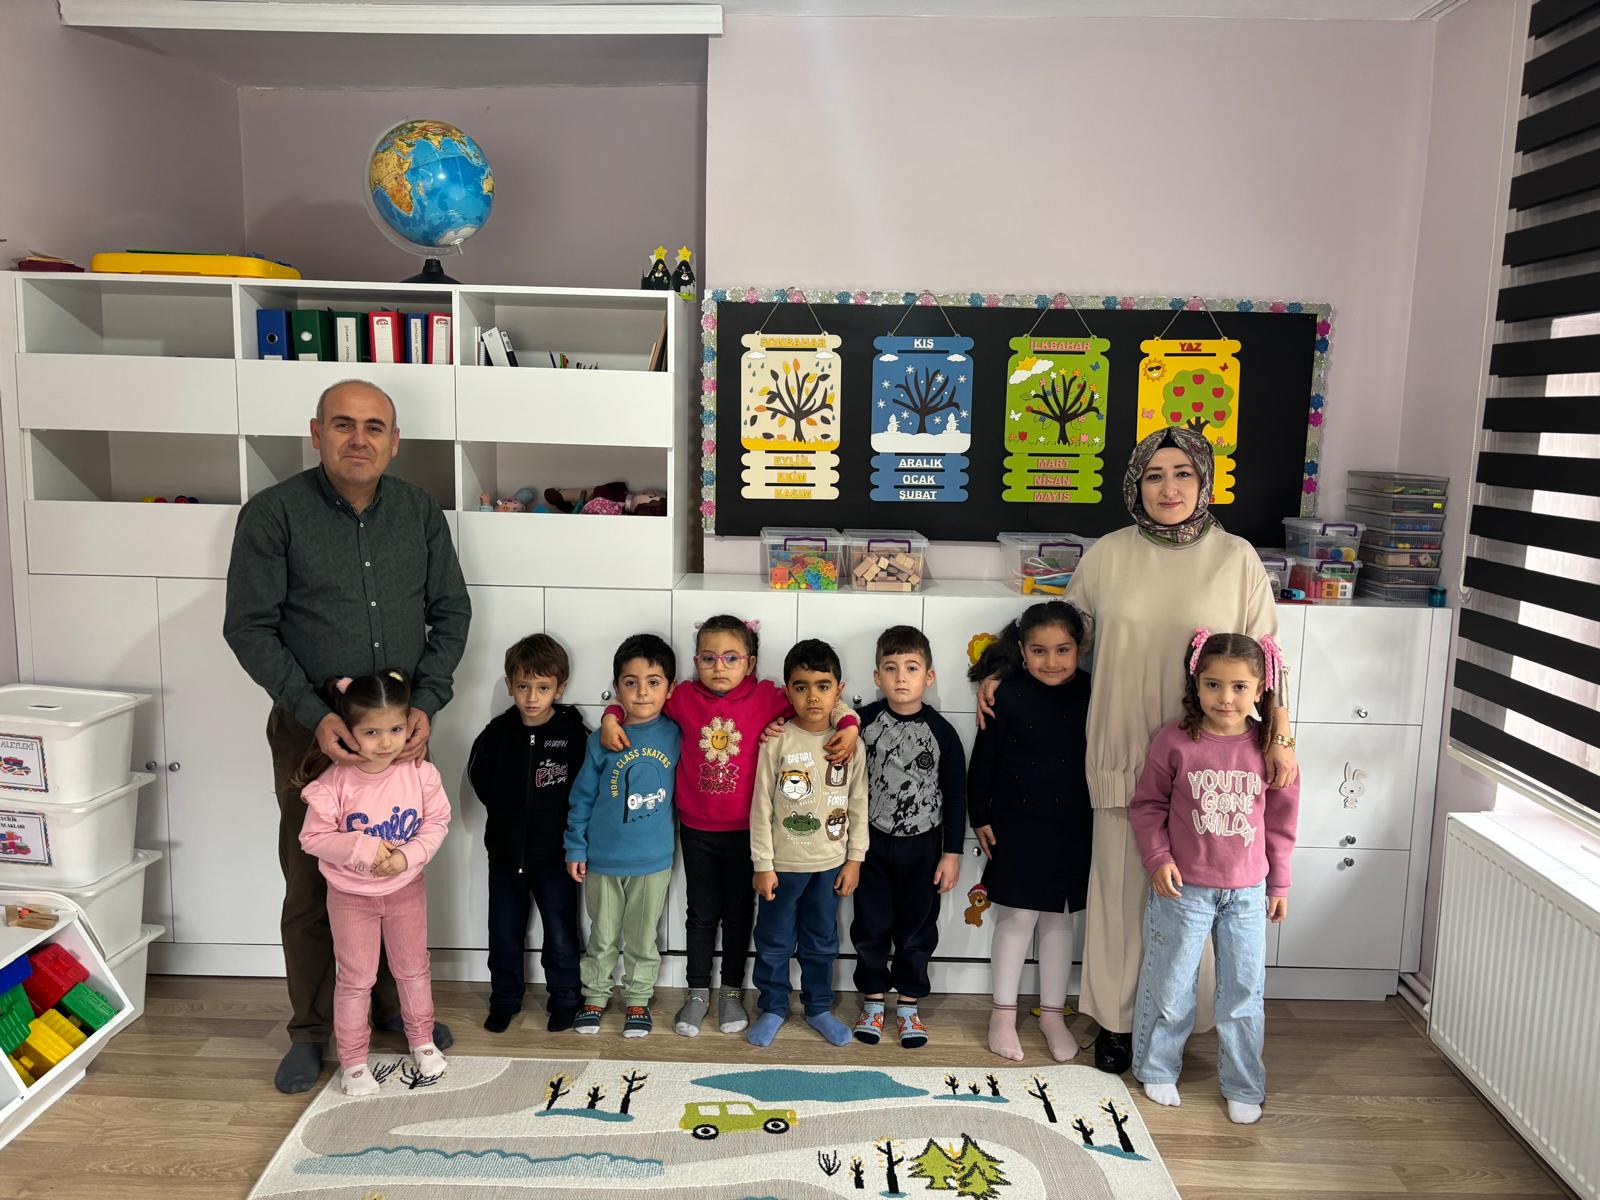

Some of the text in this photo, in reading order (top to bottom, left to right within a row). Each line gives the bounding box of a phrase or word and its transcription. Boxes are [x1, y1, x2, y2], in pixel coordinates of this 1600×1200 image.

[1179, 342, 1202, 352] YAZ
[898, 458, 943, 468] ARALIK
[1037, 459, 1072, 469] MART
[902, 474, 936, 485] OCAK
[774, 488, 812, 499] KASIM
[1033, 491, 1072, 502] MAYIS
[610, 747, 671, 798] WORLD CLASS SKATERS
[1187, 769, 1261, 799] YOUTH
[1201, 790, 1254, 814] GONE
[1192, 809, 1248, 836] WILD
